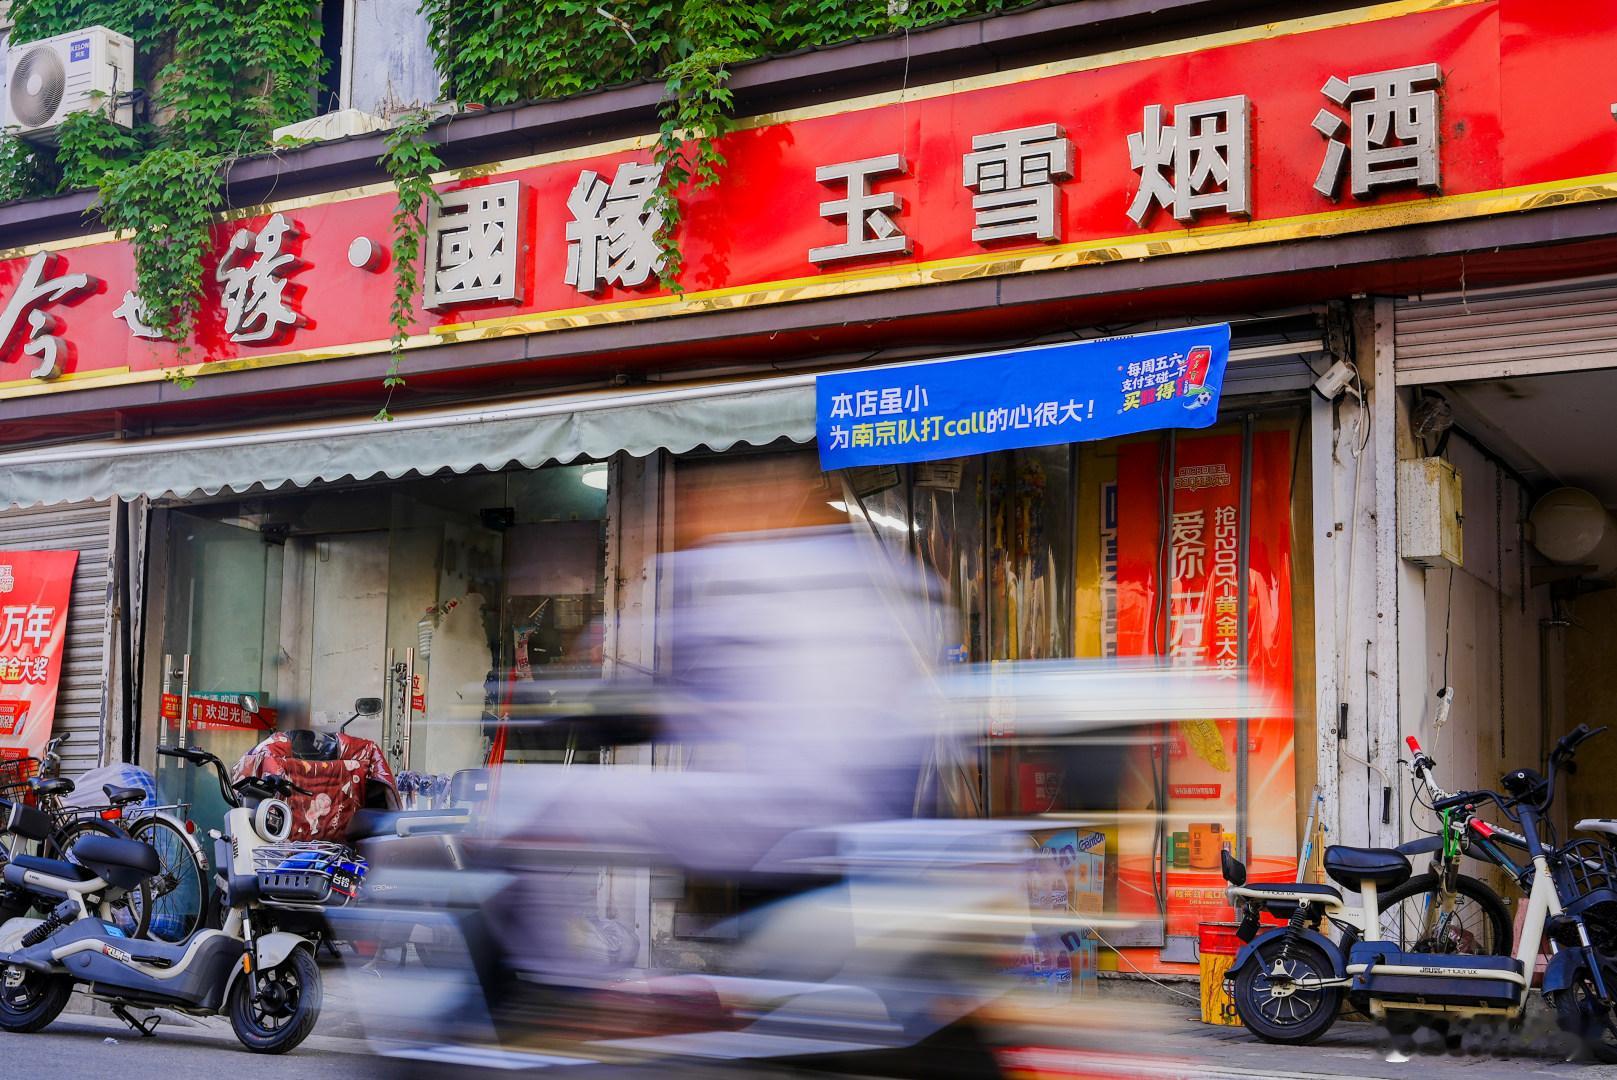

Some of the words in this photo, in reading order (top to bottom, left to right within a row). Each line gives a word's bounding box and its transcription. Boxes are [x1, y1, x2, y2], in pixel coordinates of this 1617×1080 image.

[808, 62, 1441, 266] 玉雪烟酒
[1121, 364, 1188, 392] 支付宝碰一下
[1127, 352, 1184, 377] 每周五六
[830, 384, 928, 419] 本店虽小
[1123, 380, 1184, 411] 买得
[0, 604, 54, 648] 万年
[205, 704, 252, 725] 欢迎光临
